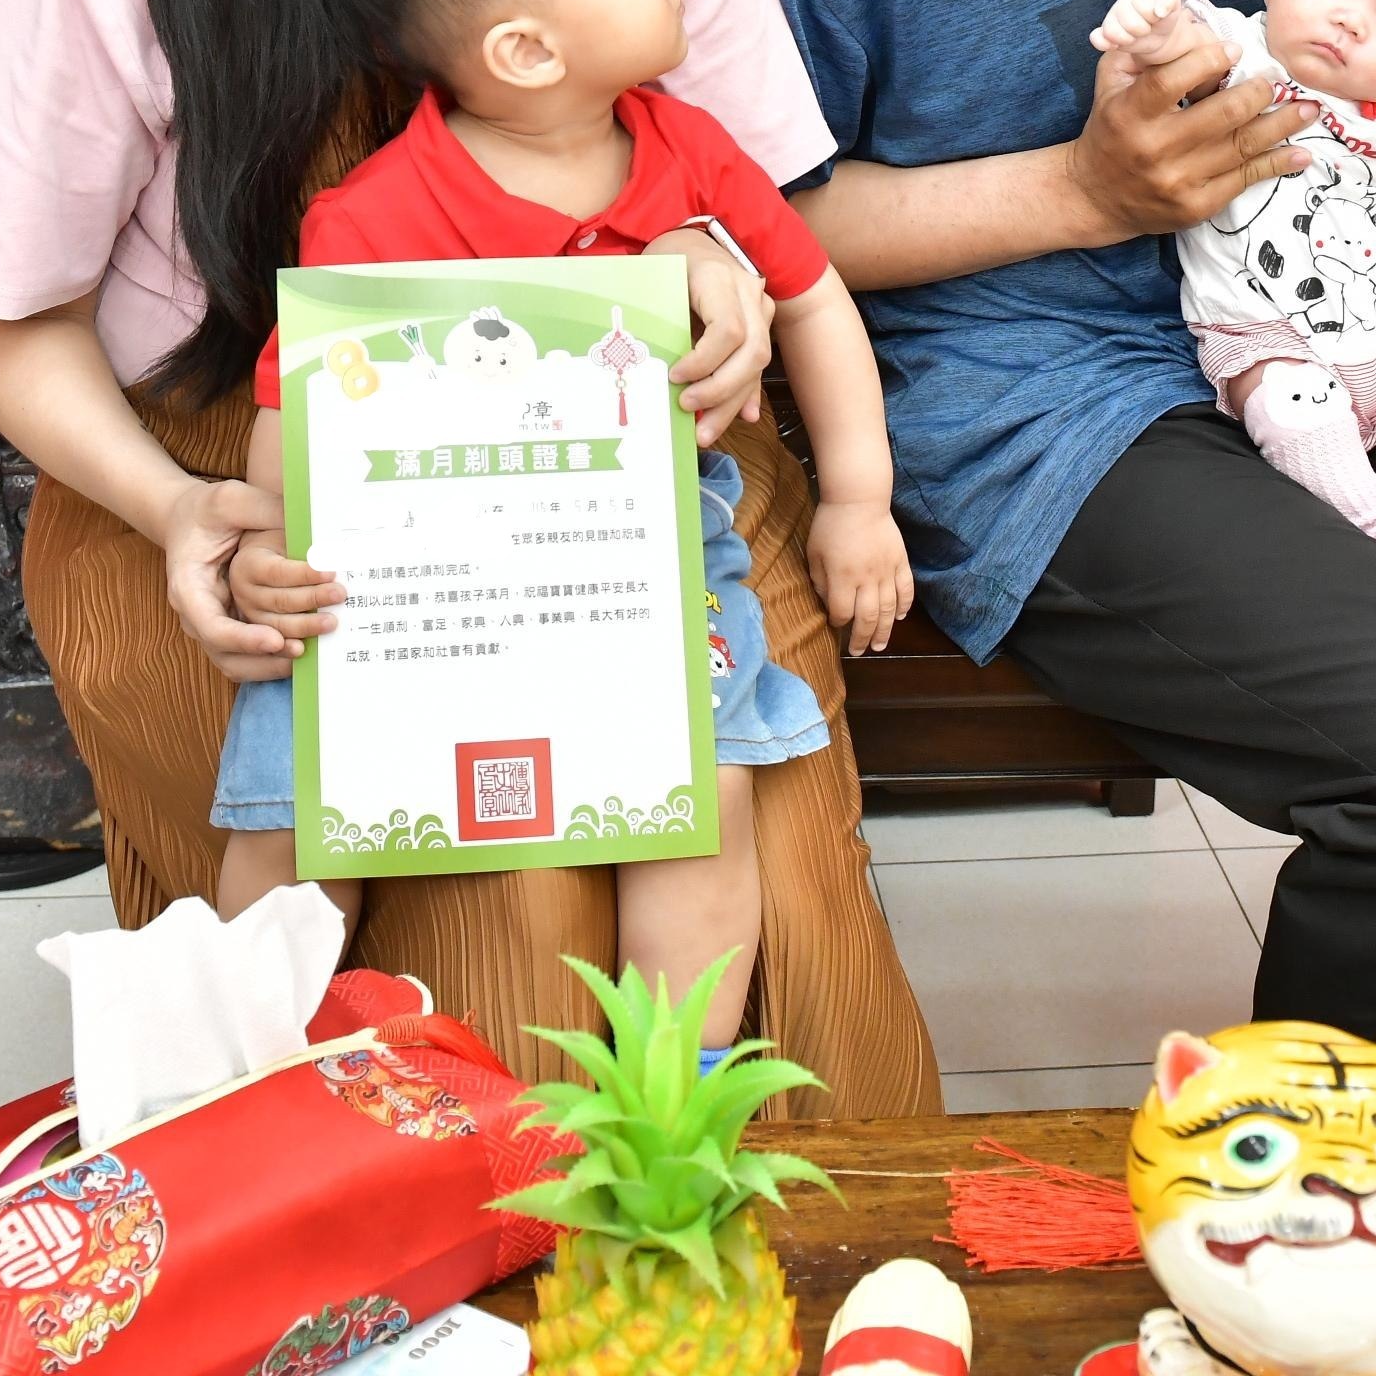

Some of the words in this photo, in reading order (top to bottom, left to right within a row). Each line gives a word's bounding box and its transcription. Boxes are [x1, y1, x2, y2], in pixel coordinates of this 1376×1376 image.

[395, 442, 592, 477] 滿月剃頭證書
[408, 1317, 462, 1360] 1000
